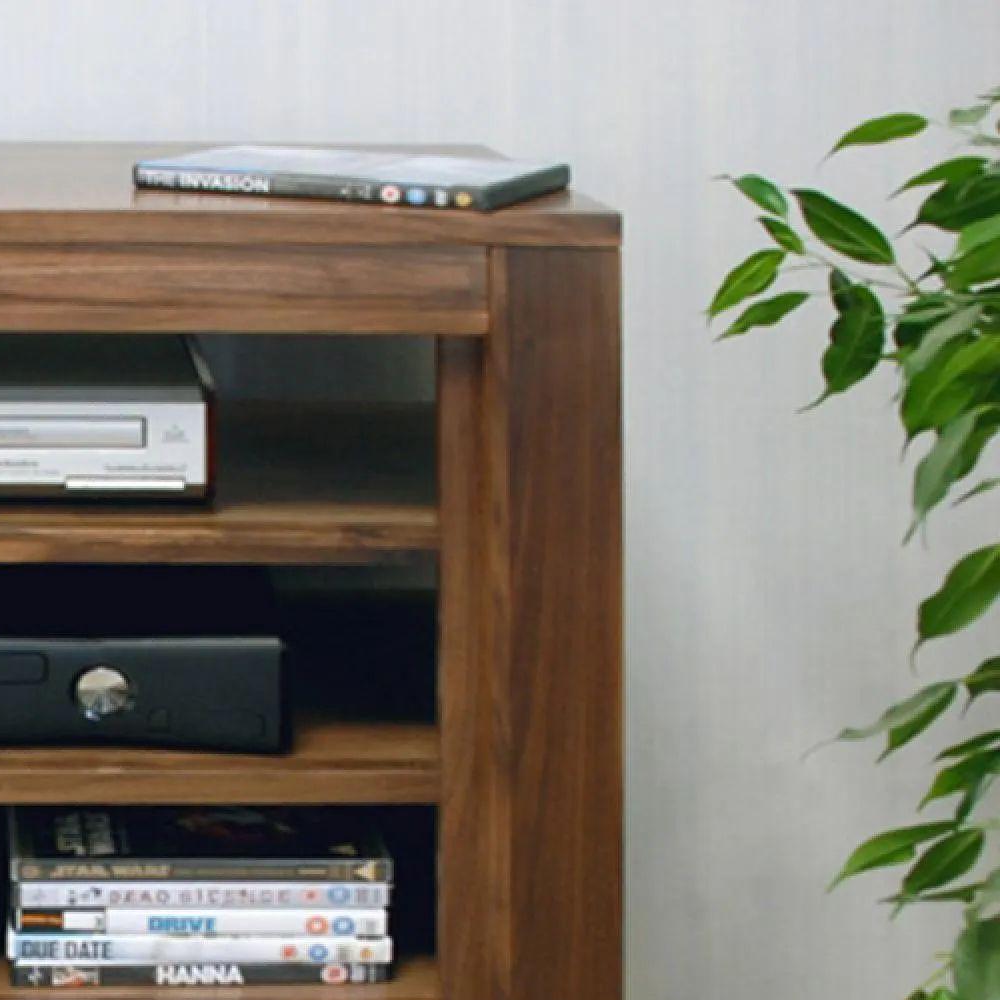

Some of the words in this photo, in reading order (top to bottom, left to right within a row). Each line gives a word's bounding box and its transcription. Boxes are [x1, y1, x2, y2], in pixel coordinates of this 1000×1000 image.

[180, 173, 269, 193] INVASION
[109, 888, 170, 906] DEAD
[148, 915, 217, 935] DRIVE
[19, 938, 58, 960] DUE
[63, 938, 113, 961] DATE
[154, 963, 245, 986] HANNA
